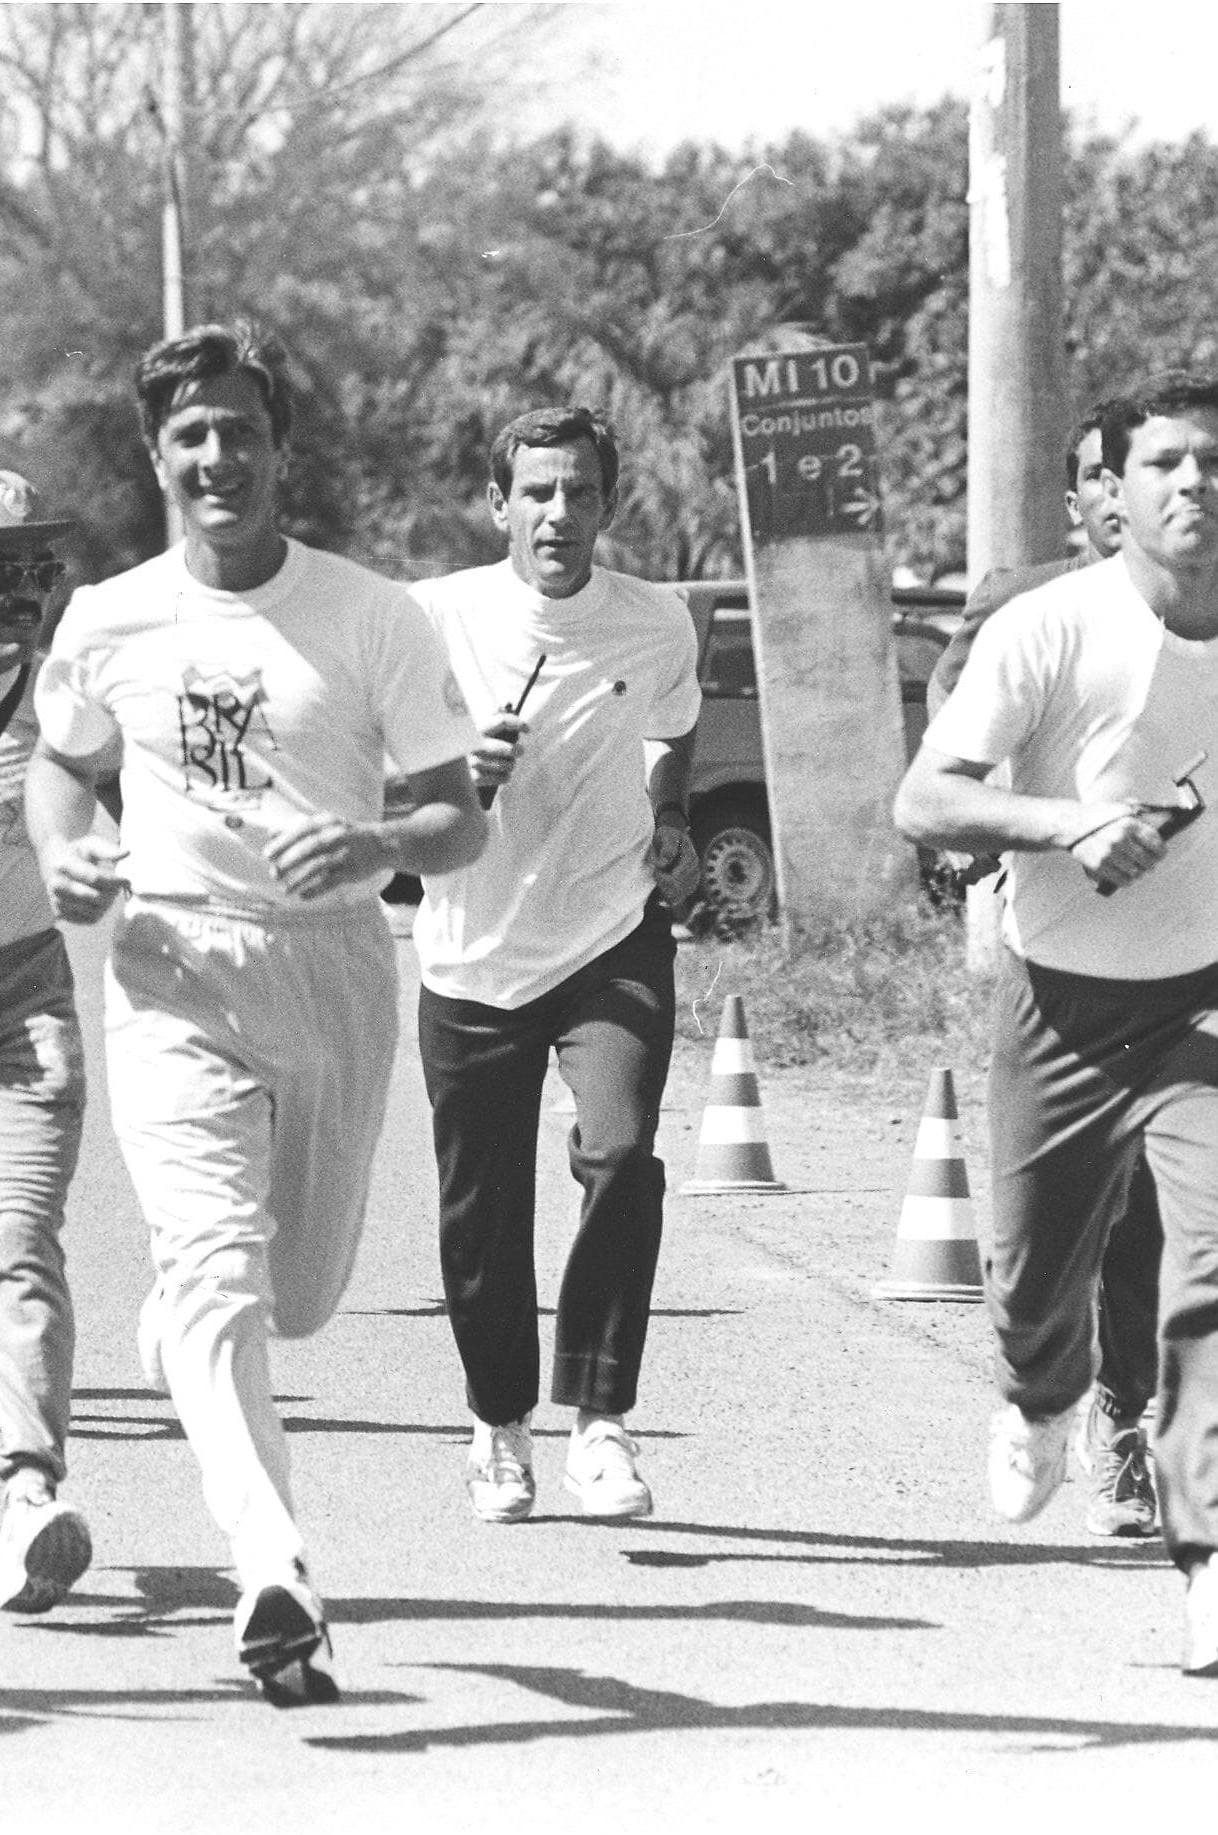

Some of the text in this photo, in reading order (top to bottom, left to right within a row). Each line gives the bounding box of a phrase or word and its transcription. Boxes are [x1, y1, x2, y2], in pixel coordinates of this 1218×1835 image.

[743, 354, 859, 398] MI 10
[763, 444, 863, 484] 1 e 2
